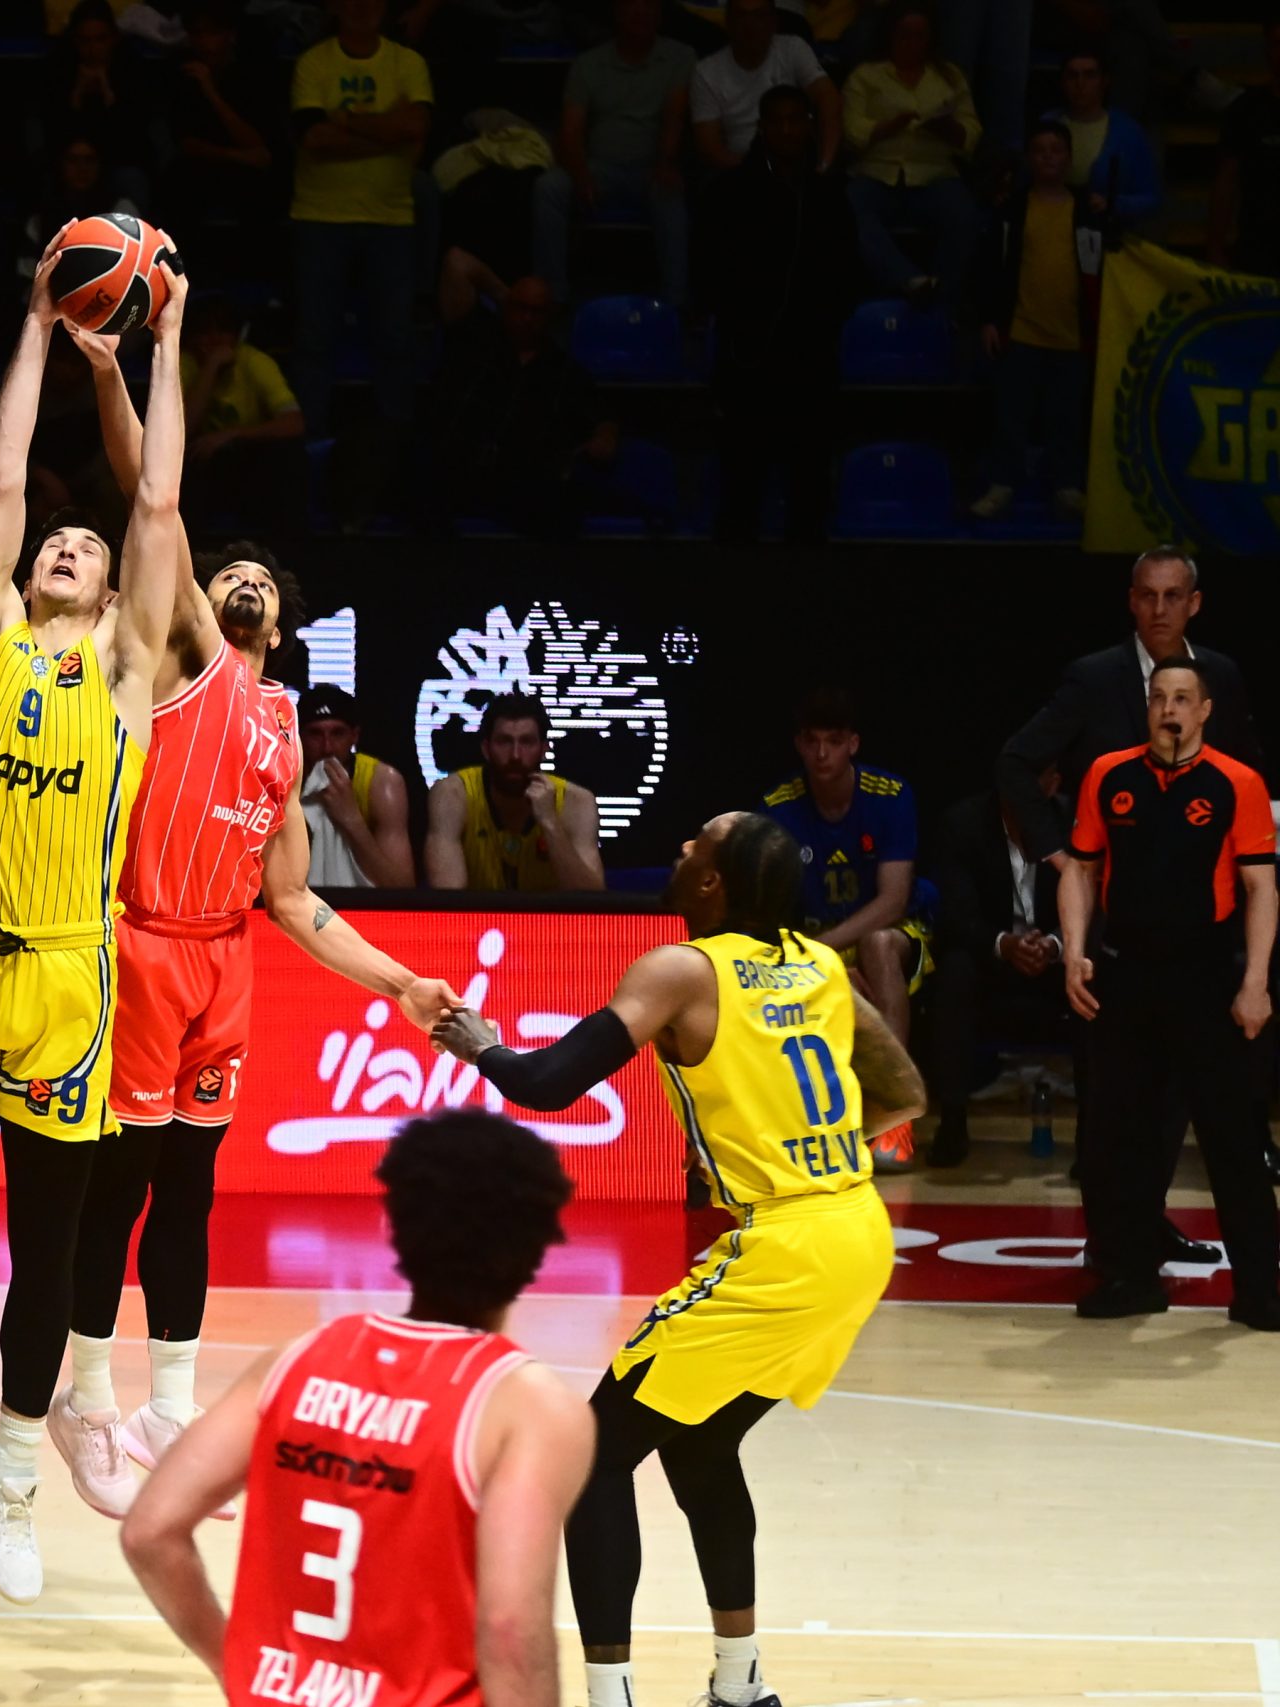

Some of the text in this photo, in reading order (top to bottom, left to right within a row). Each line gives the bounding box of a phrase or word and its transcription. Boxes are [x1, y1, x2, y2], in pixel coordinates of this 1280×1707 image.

[17, 688, 43, 738] 9
[762, 1003, 806, 1029] Am
[58, 1077, 88, 1124] 9
[293, 1376, 430, 1446] BRYANT
[292, 1498, 362, 1642] 3
